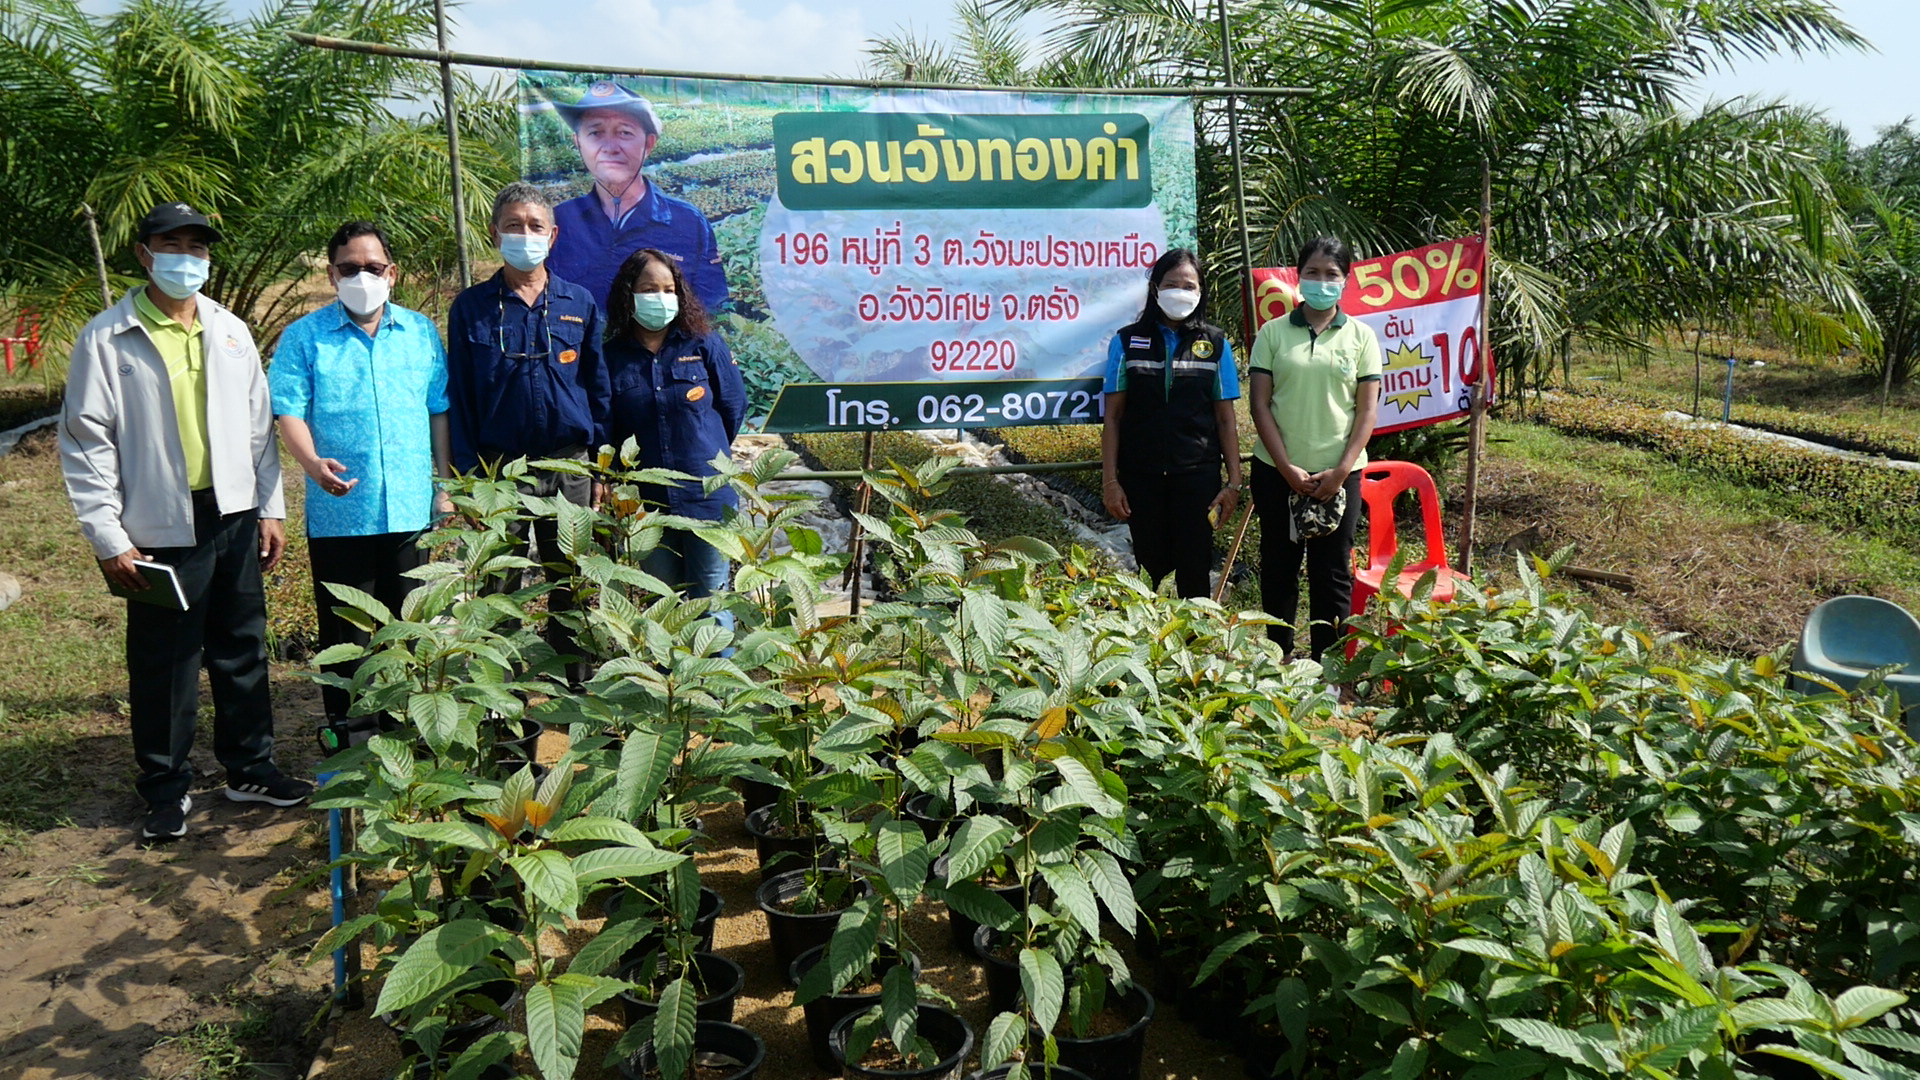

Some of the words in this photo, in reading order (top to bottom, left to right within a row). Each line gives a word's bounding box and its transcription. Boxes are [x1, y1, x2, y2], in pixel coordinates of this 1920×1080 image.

[790, 121, 1140, 184] สวนวังทองคำ
[774, 232, 829, 265] 196
[842, 221, 901, 275] หมู่ที่
[914, 234, 931, 266] 3
[943, 230, 1157, 268] ต.วังมะปรางเหนือ
[1257, 279, 1300, 322] ล
[1353, 243, 1478, 306] 50%
[858, 284, 990, 322] อ.วังวิเศษ
[1001, 286, 1080, 321] จ.ตรัง
[1384, 314, 1414, 338] ต้น
[931, 340, 1016, 371] 92220
[1384, 367, 1431, 393] แถม
[826, 388, 900, 426] โทร.
